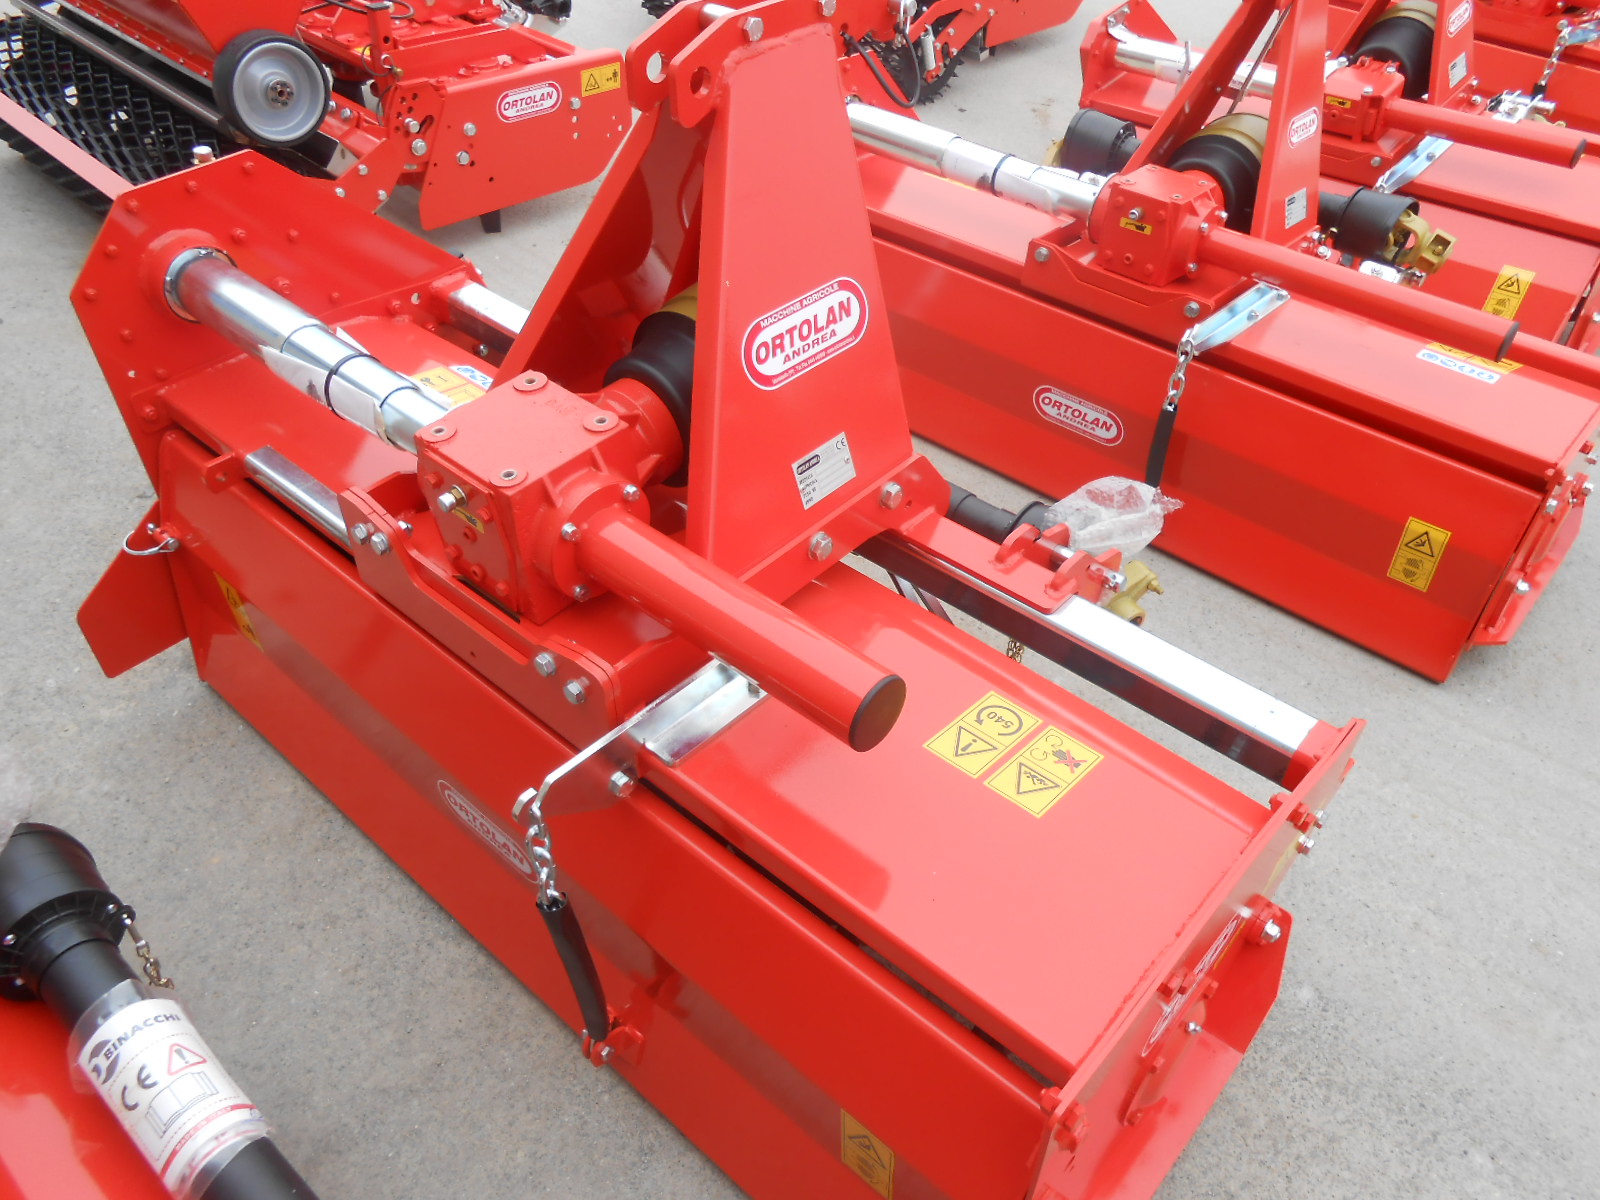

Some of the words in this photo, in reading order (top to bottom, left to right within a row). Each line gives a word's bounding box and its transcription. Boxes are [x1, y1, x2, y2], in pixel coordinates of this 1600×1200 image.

[503, 91, 554, 112] ORTOLAN
[760, 302, 802, 328] MACCHINE
[802, 282, 840, 308] AGRICOLE
[755, 296, 852, 366] ORTOLAN
[782, 328, 837, 365] ANDREA
[1041, 396, 1114, 432] ORTOLAN
[1056, 412, 1097, 432] ANDREA
[986, 711, 1015, 730] 540
[447, 792, 526, 866] ORTOLAN
[103, 1013, 182, 1062] BINACCHI
